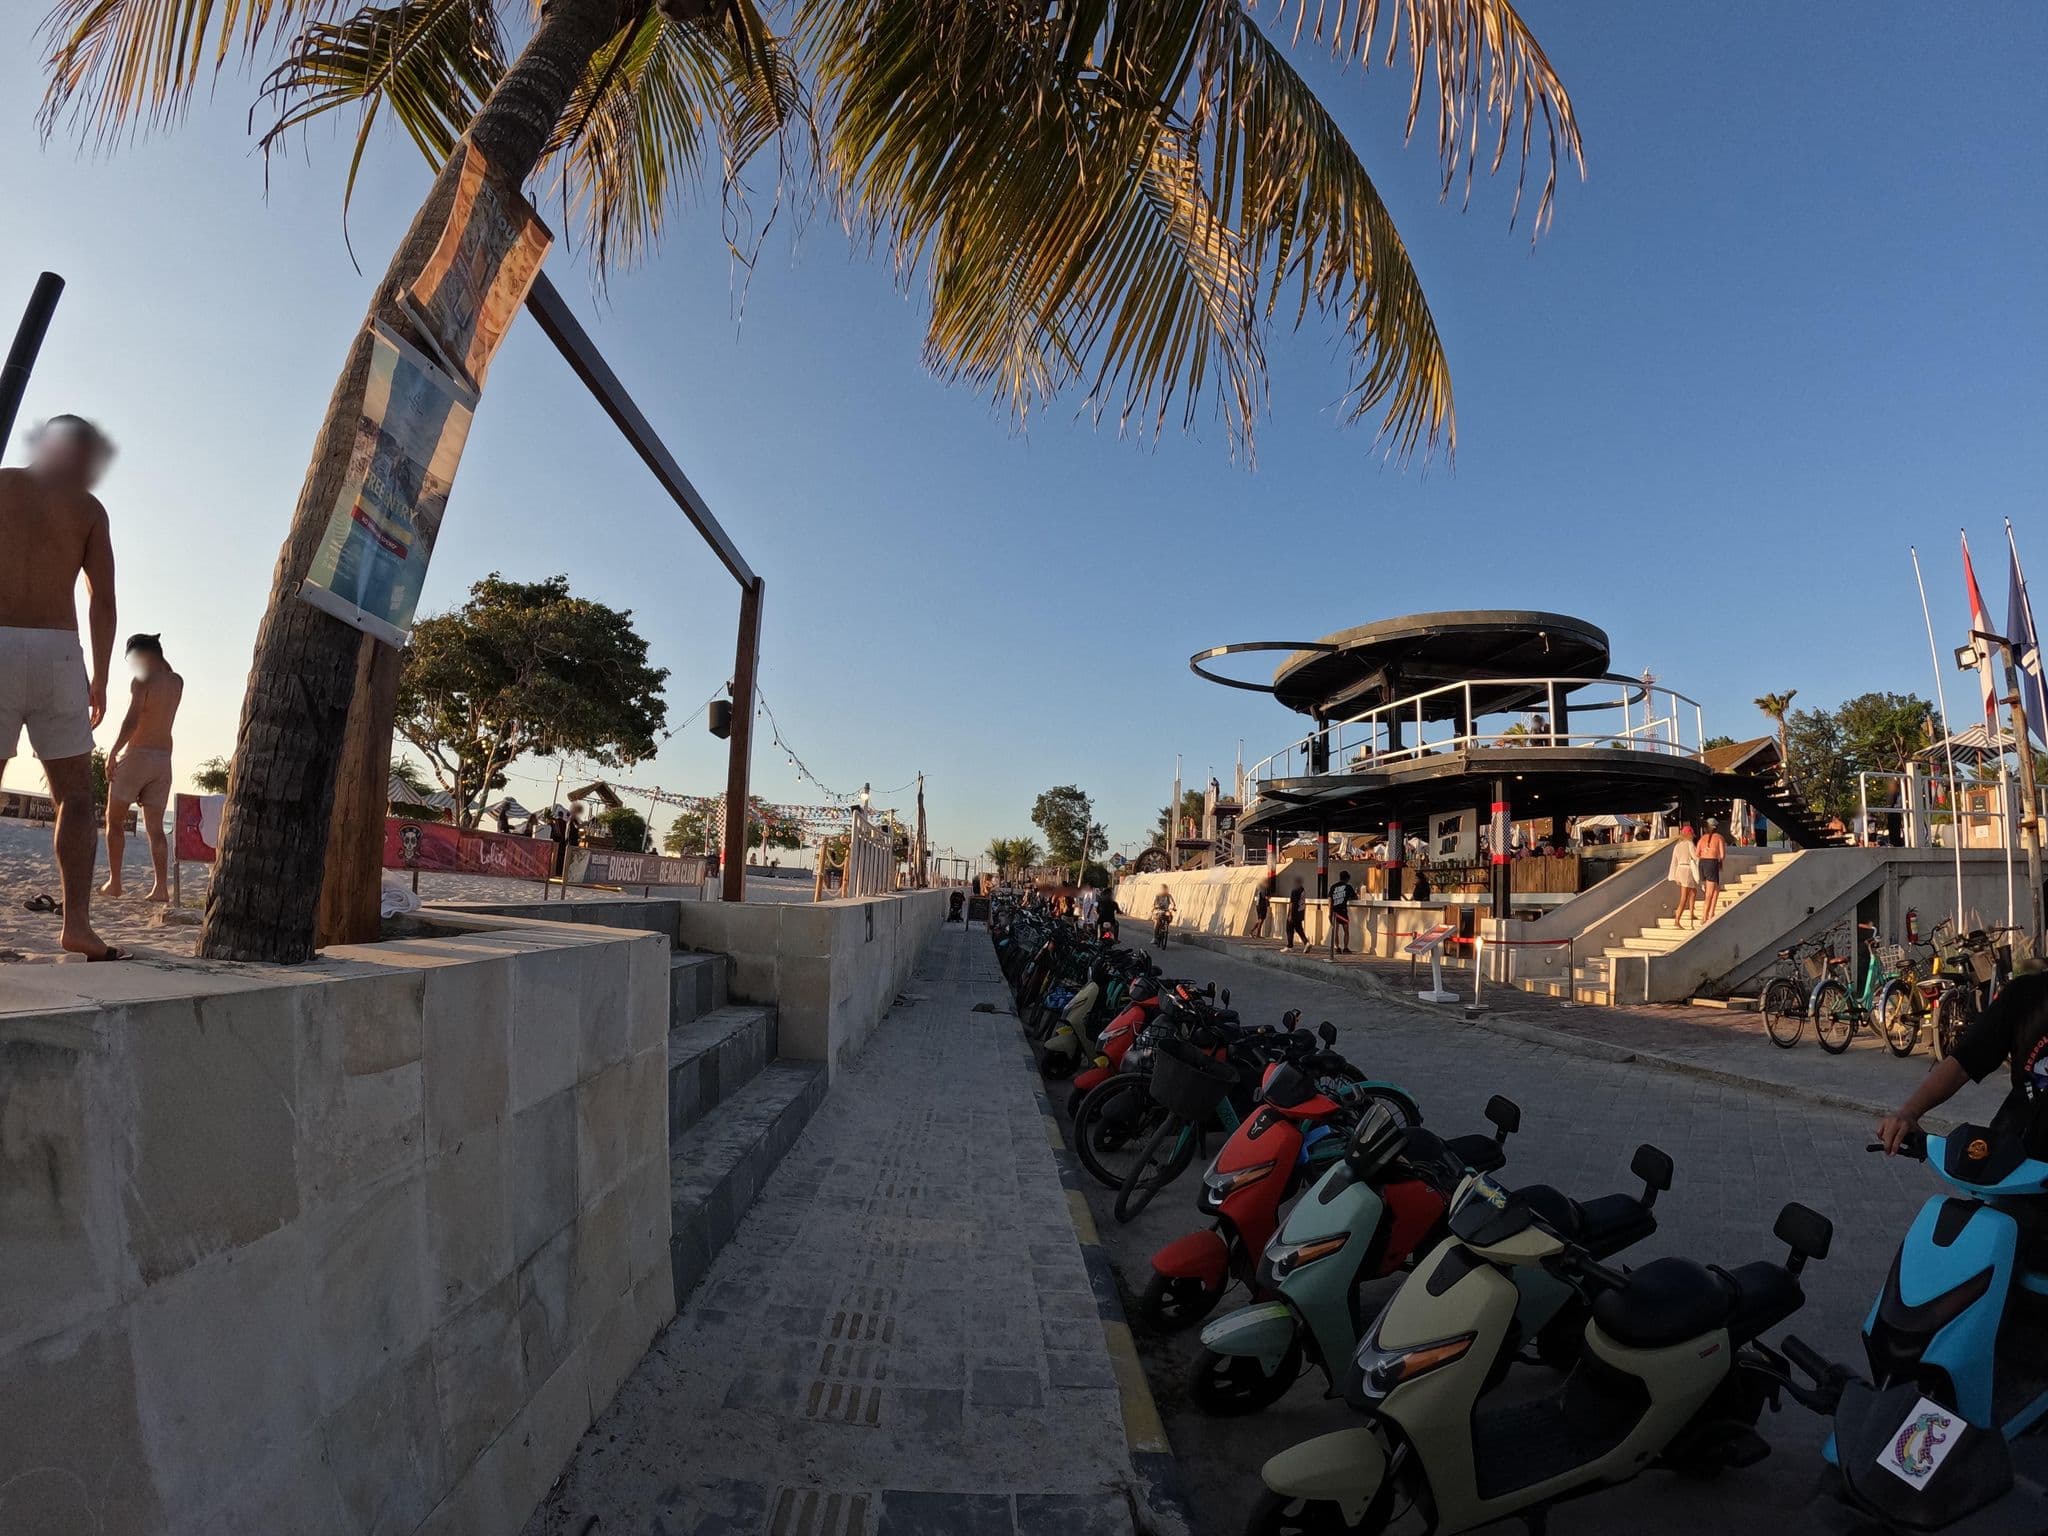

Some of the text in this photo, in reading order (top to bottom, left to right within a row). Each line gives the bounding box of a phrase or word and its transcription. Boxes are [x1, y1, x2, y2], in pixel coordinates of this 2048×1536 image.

[608, 856, 643, 881] BIGGEST
[659, 861, 681, 883] BEACH
[680, 863, 697, 884] CLUB
